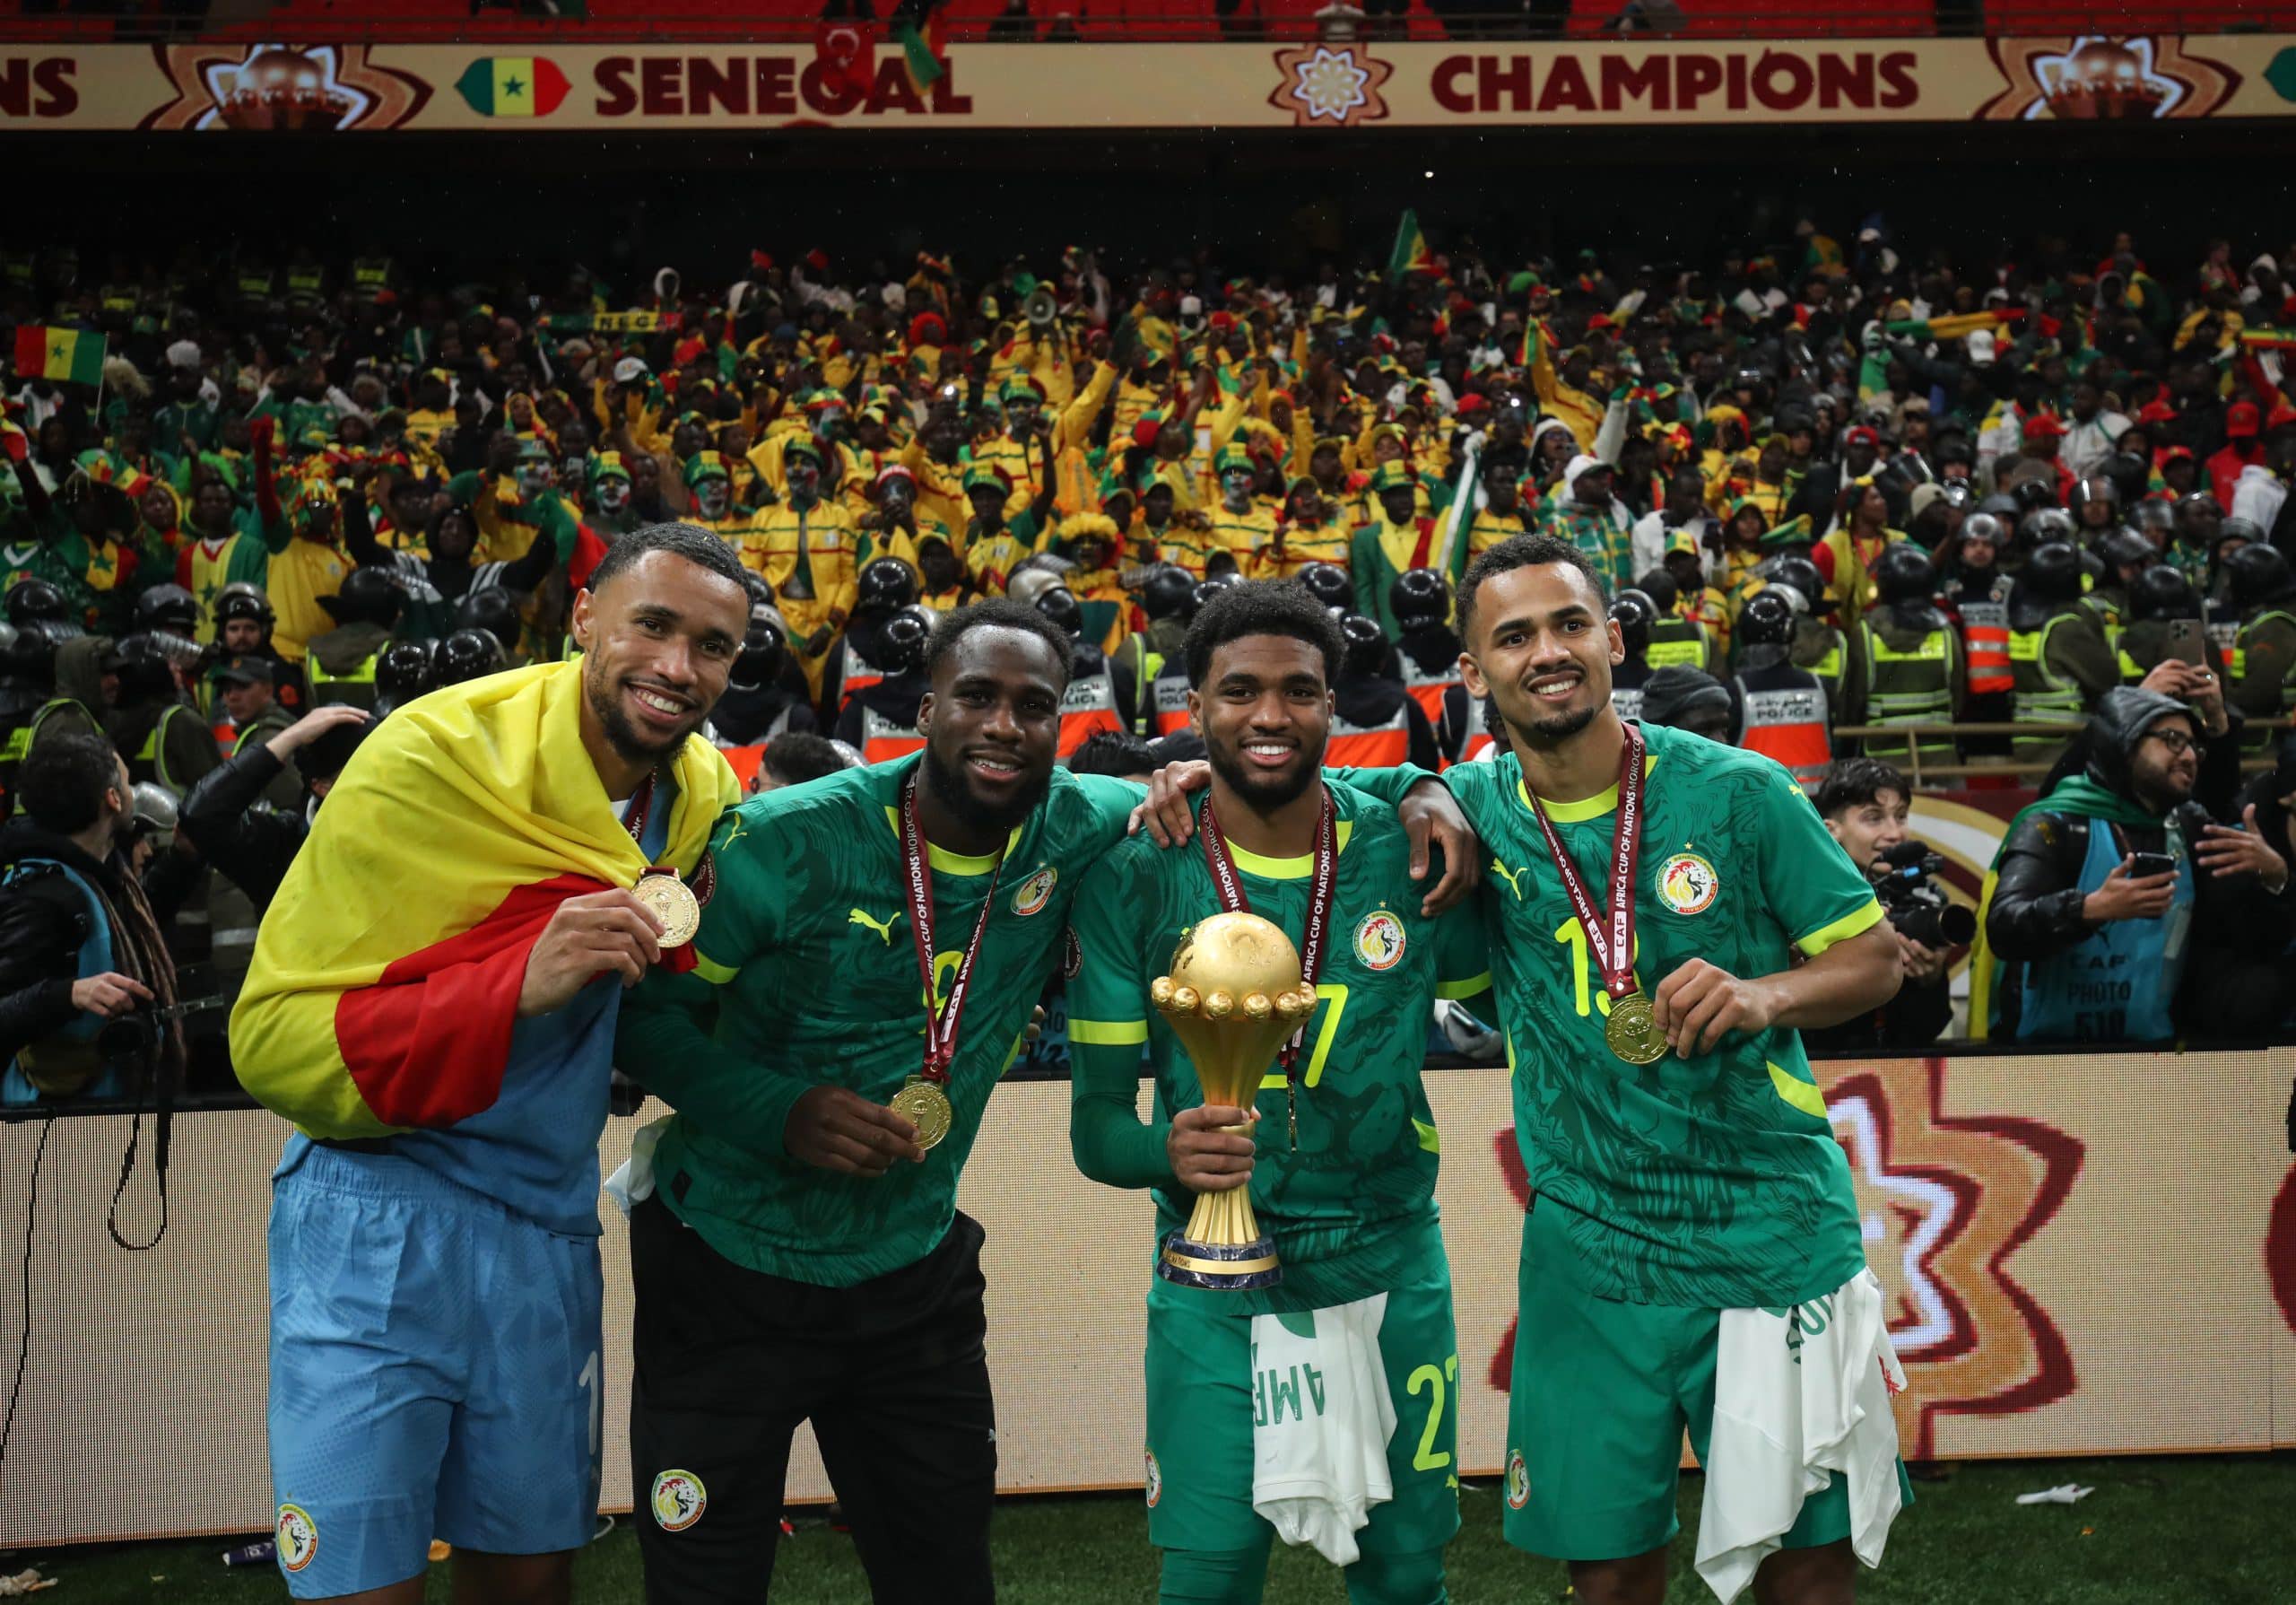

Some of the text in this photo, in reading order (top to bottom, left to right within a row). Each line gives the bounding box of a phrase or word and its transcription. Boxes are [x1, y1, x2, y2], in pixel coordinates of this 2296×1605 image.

[596, 57, 973, 117] SENEGAL
[1431, 48, 1919, 114] CHAMPIONS
[904, 801, 918, 856] MOROCCO
[1615, 737, 1641, 909] AFRICA CUP OF NATIONS MOROCCO
[909, 856, 926, 903] NATIONS
[1217, 860, 1240, 909] NATIONS
[1303, 796, 1331, 981] AFRICA CUP OF NATIONS MOROCCO
[1564, 867, 1576, 886] CUP
[917, 904, 927, 919] OF
[1573, 884, 1591, 920] AFRICA
[921, 920, 931, 942] CUP
[1590, 927, 1607, 955] CAF
[1615, 918, 1626, 947] CAF
[925, 945, 935, 984] AFRICA
[2066, 980, 2132, 1005] PHOTO
